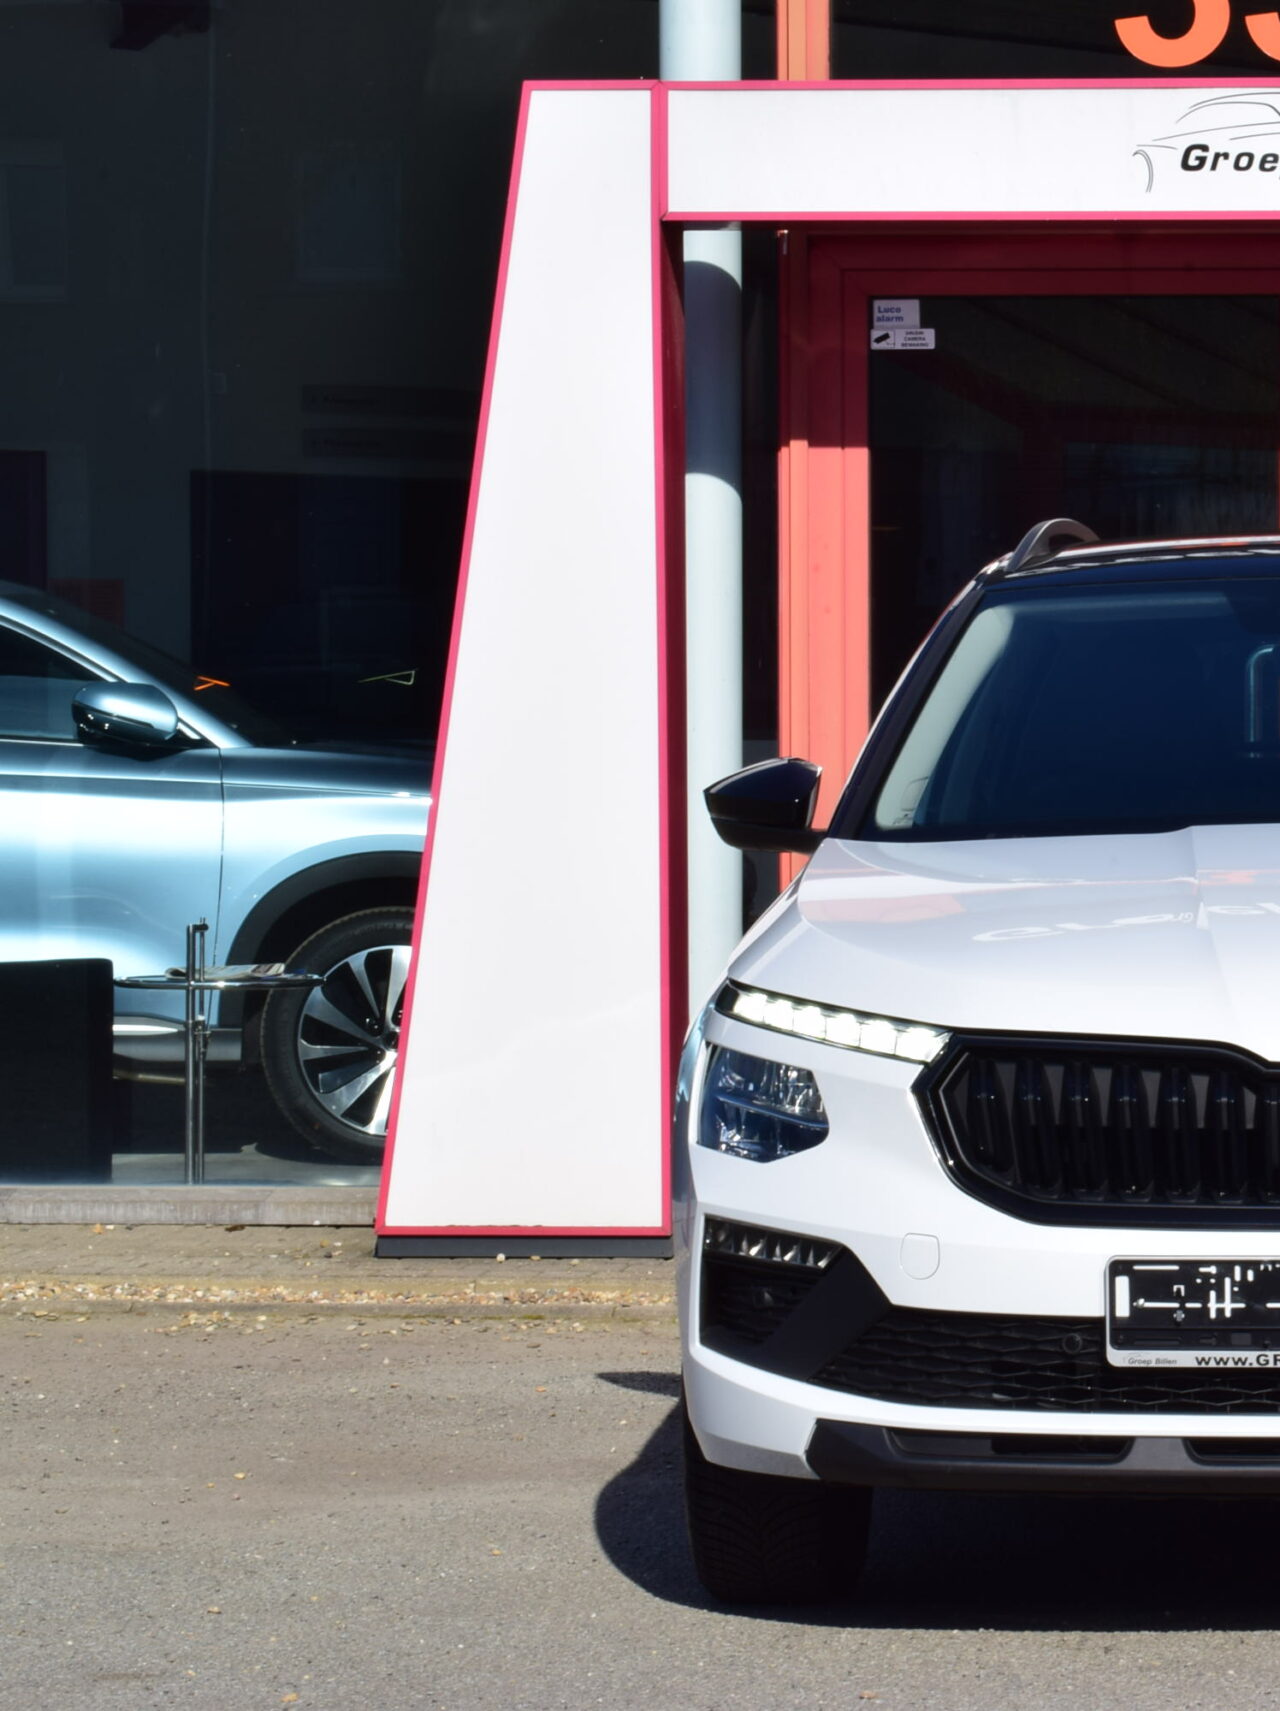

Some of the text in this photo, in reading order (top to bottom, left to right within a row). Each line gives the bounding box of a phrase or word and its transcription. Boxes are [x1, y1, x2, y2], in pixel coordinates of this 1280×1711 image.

[877, 305, 902, 314] Luco
[876, 314, 905, 323] alarm
[1127, 1356, 1178, 1366] Groep Billen
